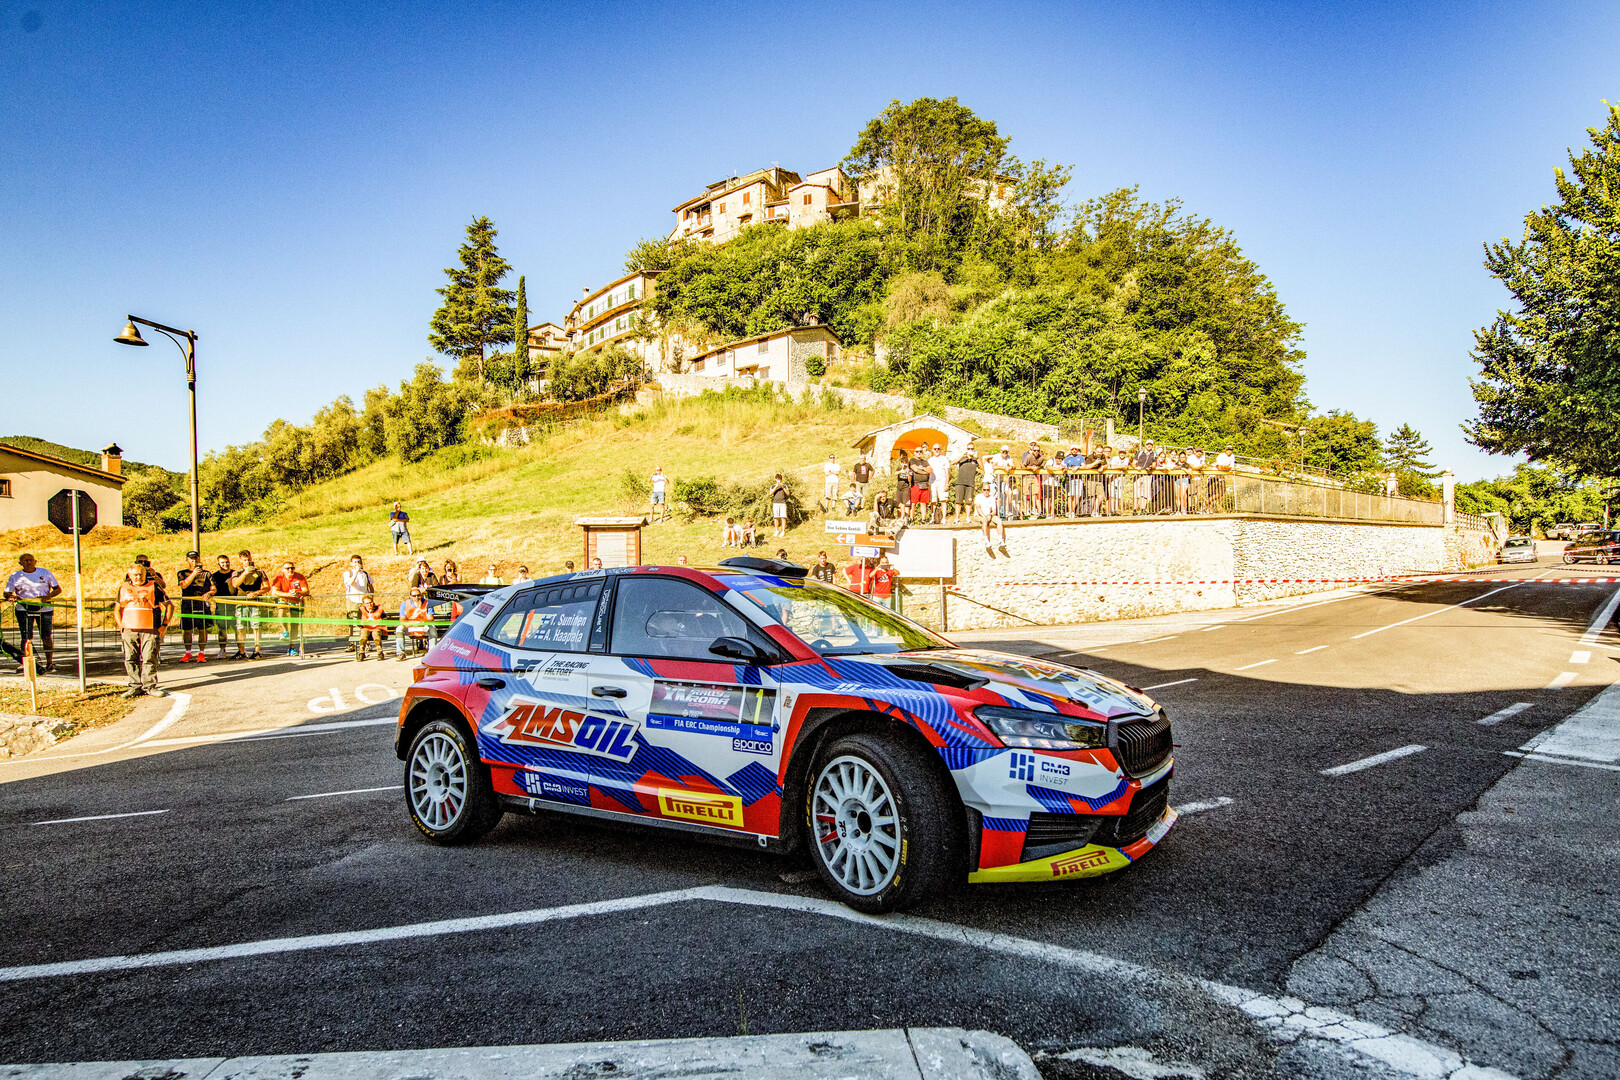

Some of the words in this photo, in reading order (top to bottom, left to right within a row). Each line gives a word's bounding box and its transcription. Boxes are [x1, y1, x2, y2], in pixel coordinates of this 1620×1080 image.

[550, 614, 557, 625] T.
[558, 614, 587, 626] Suninen
[543, 629, 551, 641] A.
[553, 629, 583, 644] Haapala
[551, 660, 565, 668] THE
[563, 661, 589, 669] RACING
[544, 668, 574, 677] FACTORY
[886, 689, 925, 701] INVEST
[753, 688, 764, 725] 1
[493, 698, 635, 758] AMSOIL
[674, 719, 684, 727] FIA
[685, 720, 697, 729] ERC
[698, 722, 740, 735] Championship
[733, 738, 772, 752] sparco
[1041, 761, 1070, 776] CM3
[1039, 774, 1069, 786] INVEST
[543, 782, 561, 793] CM3
[562, 785, 587, 797] INVEST
[665, 794, 734, 821] PIRELLI
[1050, 850, 1110, 877] PIRELLI
